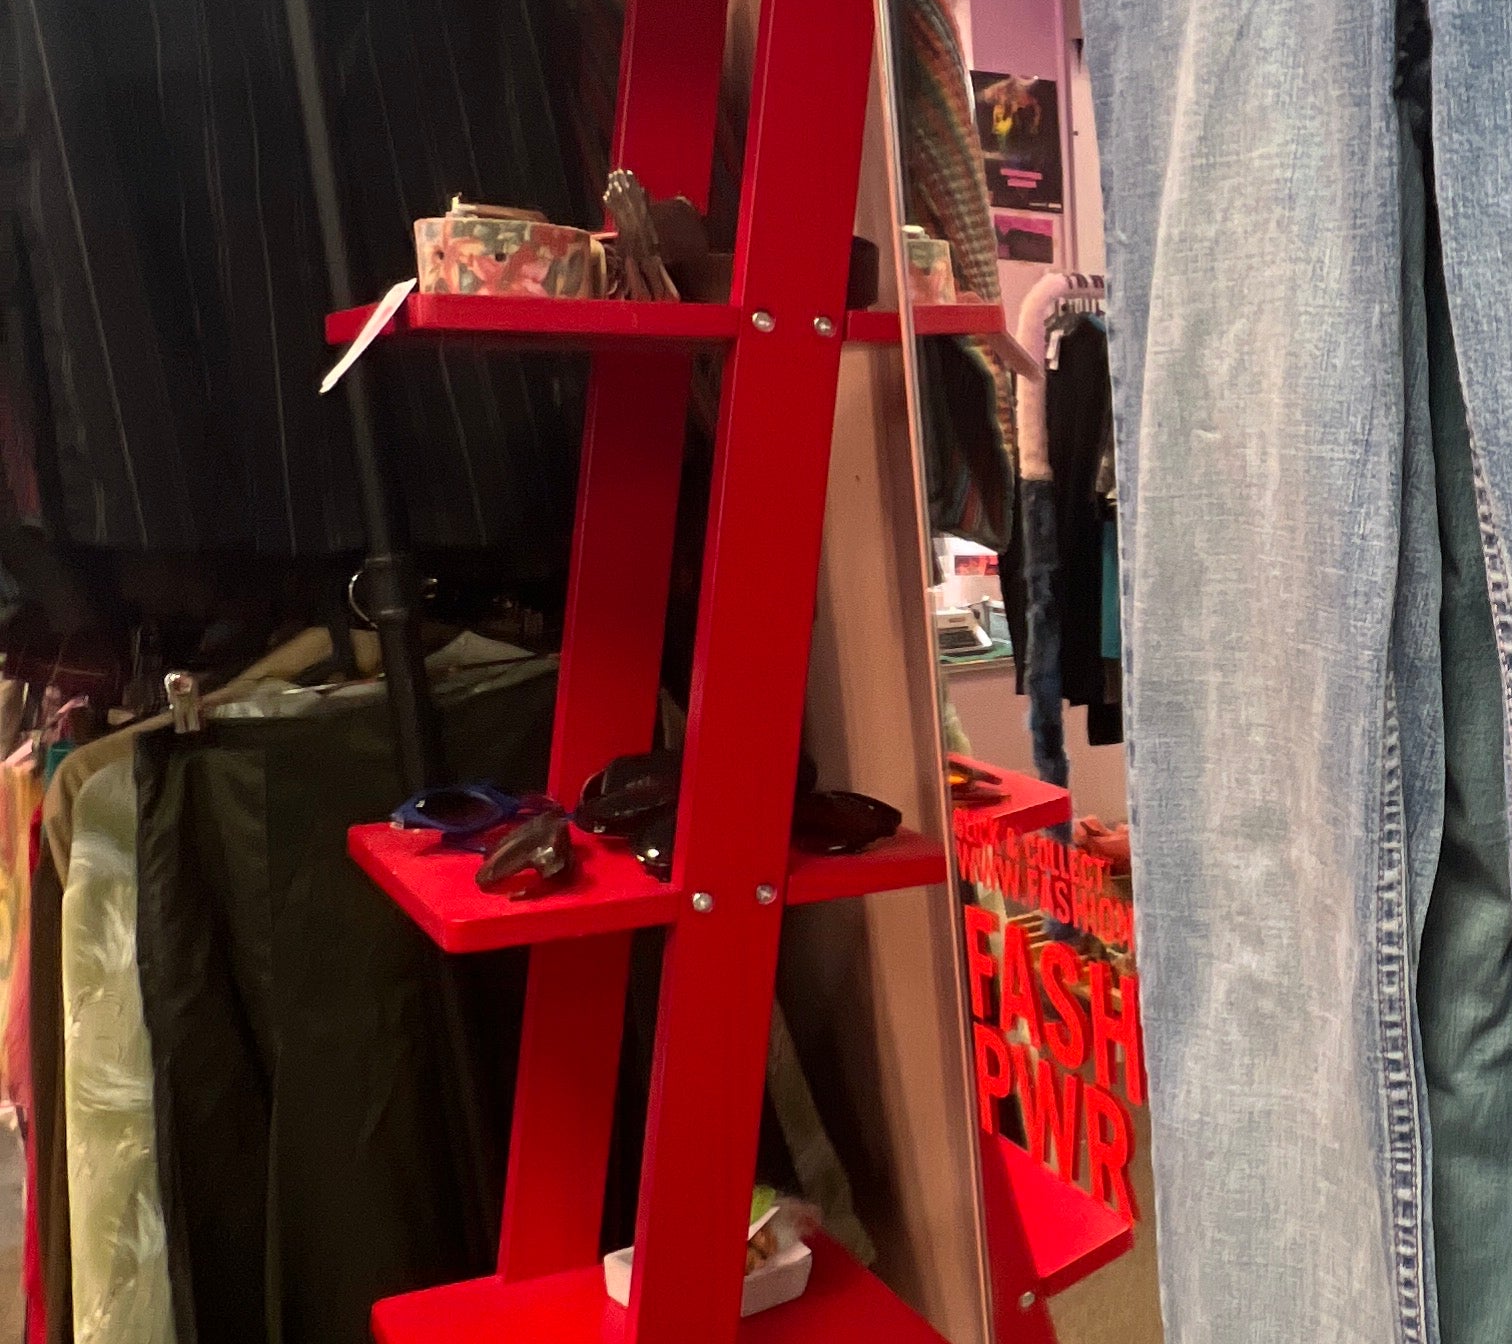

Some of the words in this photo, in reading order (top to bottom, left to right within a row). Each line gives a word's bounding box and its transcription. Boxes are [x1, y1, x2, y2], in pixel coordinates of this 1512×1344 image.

[1023, 832, 1108, 894] COLLECT
[963, 904, 1143, 1106] FASH
[973, 1022, 1134, 1228] PWR
